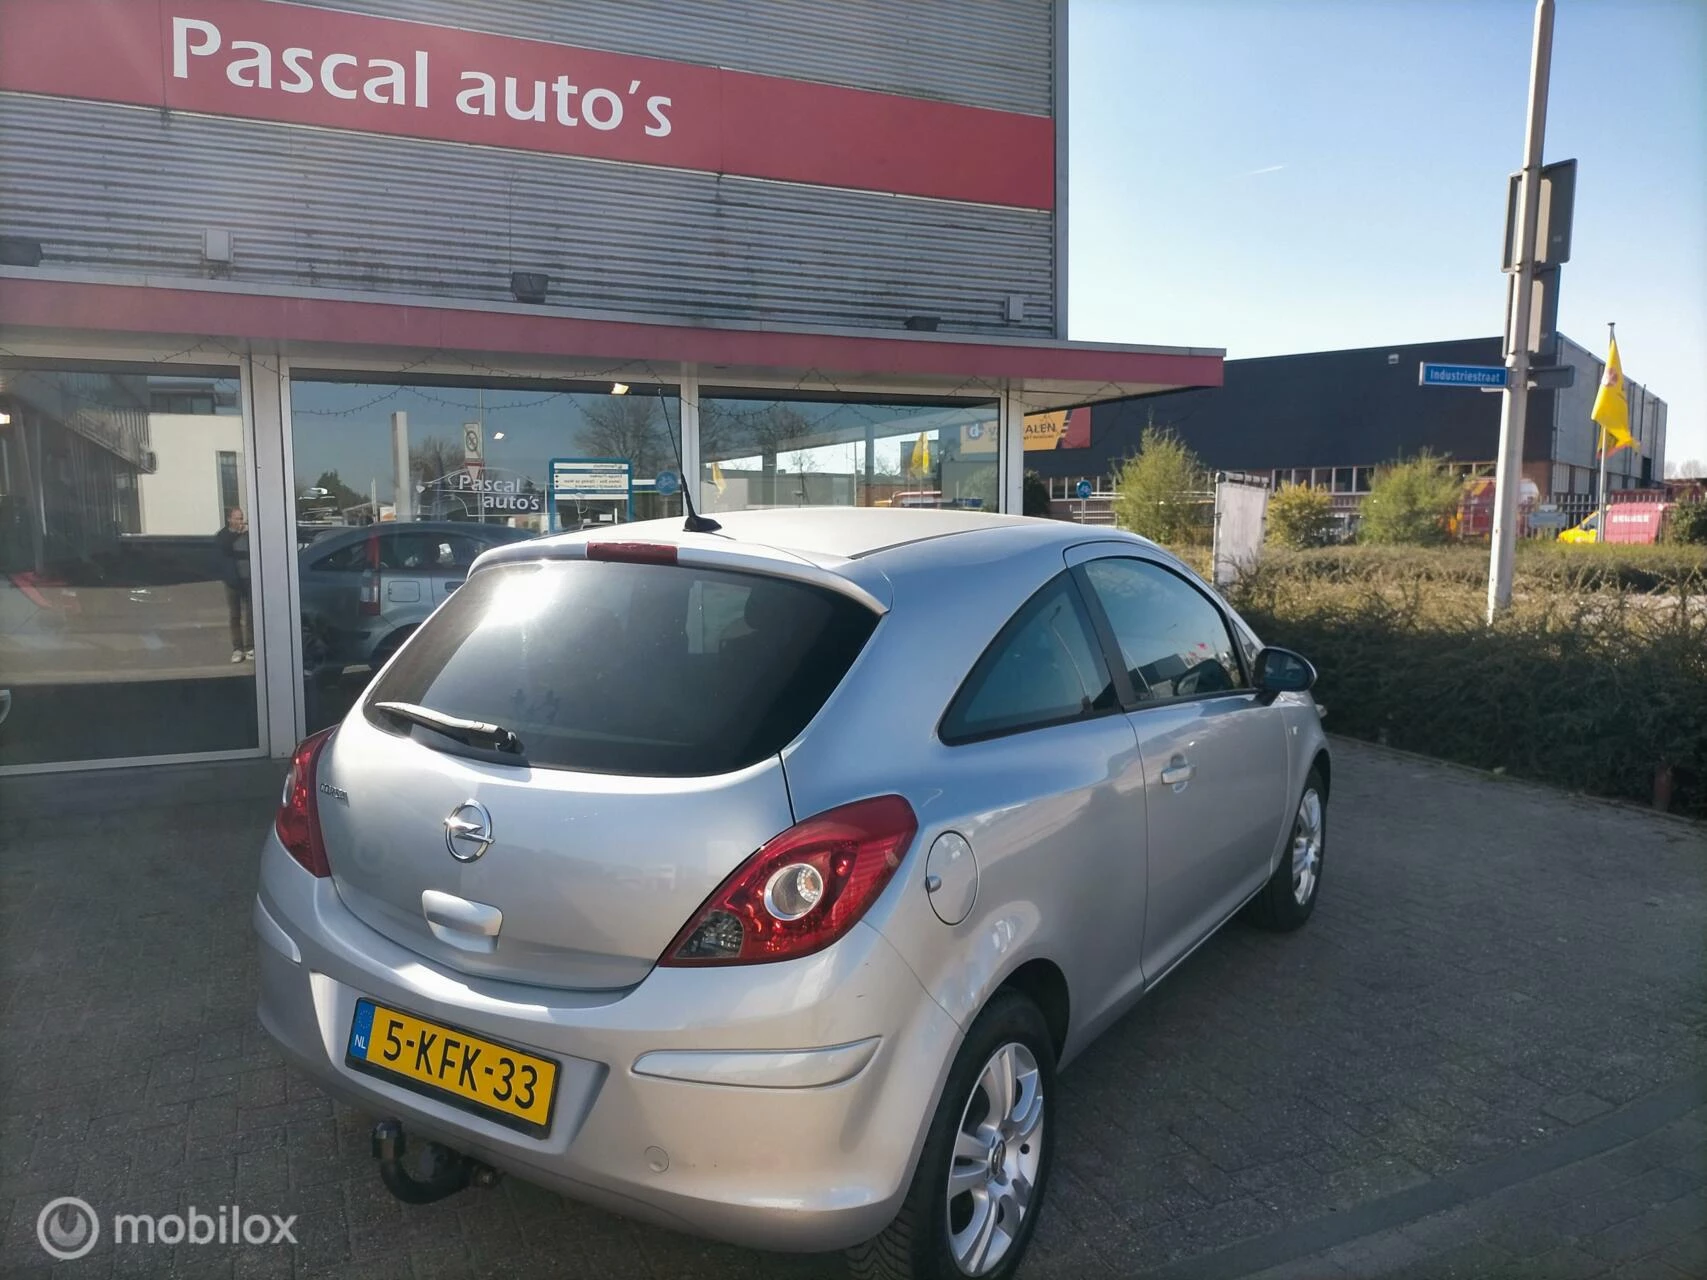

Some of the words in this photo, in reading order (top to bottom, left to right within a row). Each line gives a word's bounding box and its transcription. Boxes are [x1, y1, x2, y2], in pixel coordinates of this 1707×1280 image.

[172, 17, 428, 108] Pascal
[455, 69, 673, 138] auto's
[1430, 368, 1500, 383] Industriestraat
[1025, 422, 1057, 434] ALEN
[459, 475, 520, 493] Pascal
[484, 495, 540, 511] auto's
[354, 1035, 367, 1050] NL
[383, 1019, 538, 1110] 5-KFK-33
